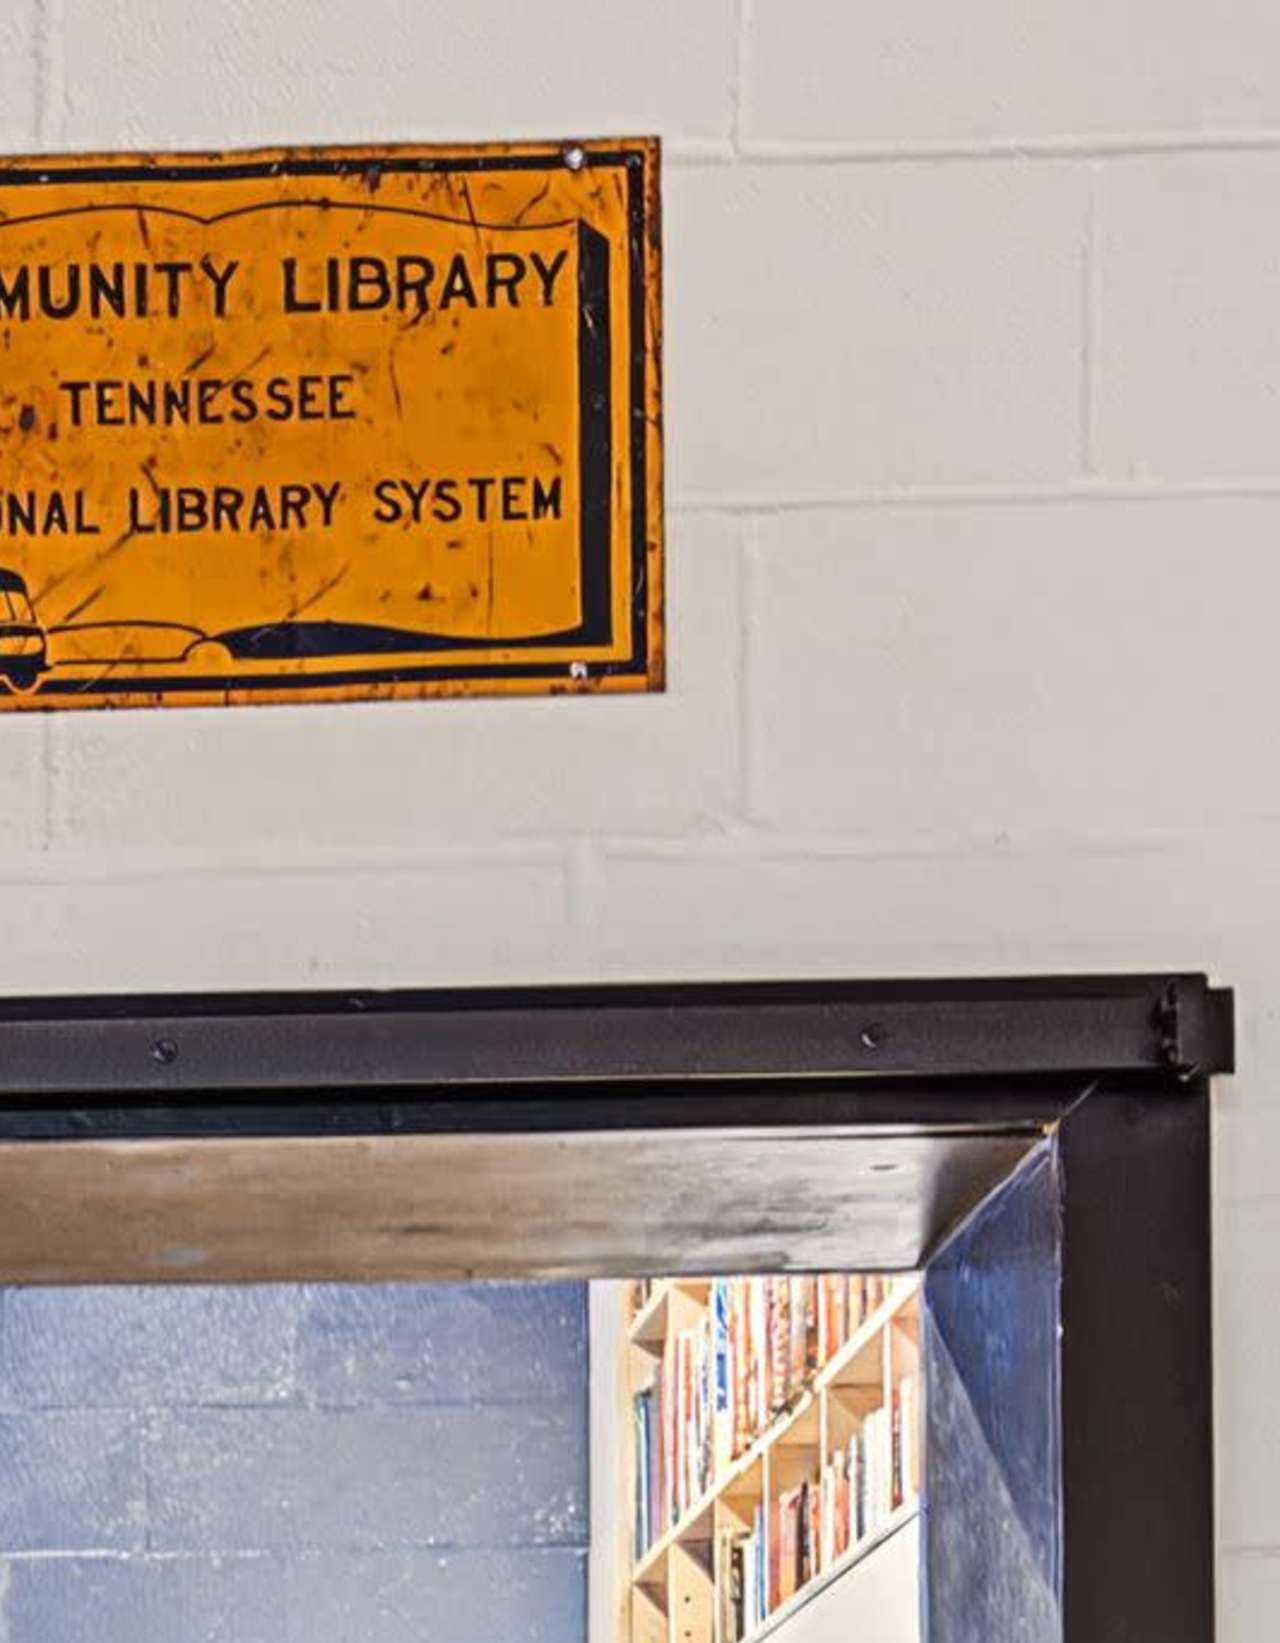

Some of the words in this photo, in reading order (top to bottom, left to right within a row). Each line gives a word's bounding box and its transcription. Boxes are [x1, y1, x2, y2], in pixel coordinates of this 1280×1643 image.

[283, 248, 568, 314] LIBRARY
[61, 375, 356, 426] TENNESSEE
[131, 481, 343, 534] LIBRARY
[375, 476, 563, 526] SYSTEM
